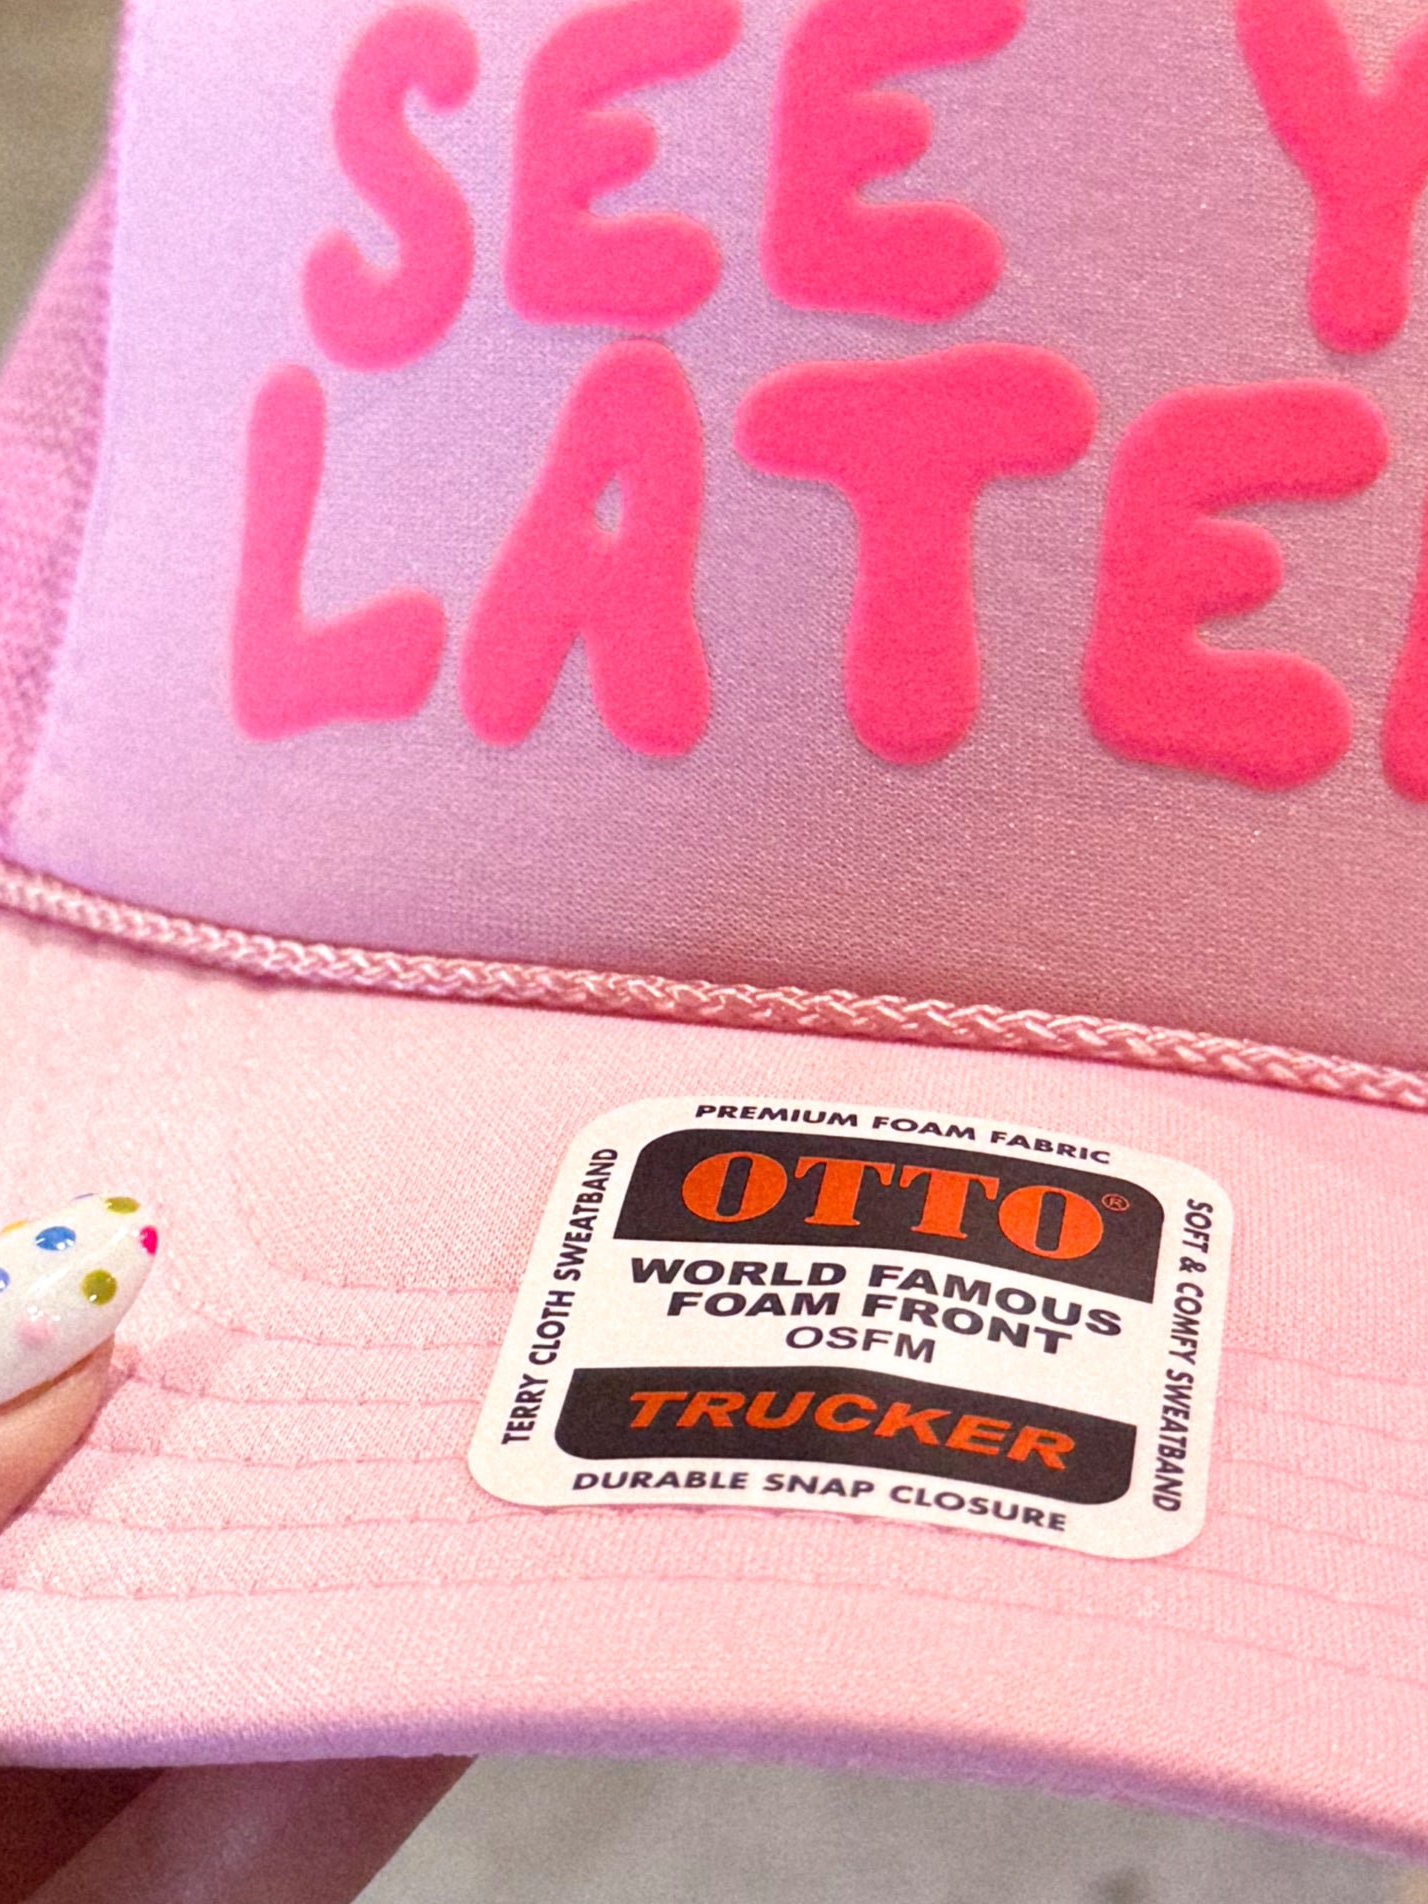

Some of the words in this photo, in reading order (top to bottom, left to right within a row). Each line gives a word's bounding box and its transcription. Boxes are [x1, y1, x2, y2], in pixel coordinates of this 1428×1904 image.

[695, 1104, 859, 1128] PREMIUM
[872, 1116, 976, 1141] FOAM
[990, 1130, 1111, 1164] FABRIC
[681, 1151, 1104, 1260] OTTO
[1185, 1199, 1213, 1253] SOFT
[501, 1369, 550, 1445] TERRY
[528, 1289, 576, 1365] CLOTH
[554, 1147, 618, 1282] SWEATBAND
[631, 1258, 847, 1287] WORLD
[869, 1263, 1123, 1336] FAMOUS
[1181, 1256, 1207, 1273] &
[667, 1291, 840, 1317] FOAM
[862, 1294, 1072, 1355] FRONT
[785, 1326, 935, 1363] OSFM
[1170, 1278, 1205, 1365] COMFY
[627, 1390, 1075, 1471] TRUCKER
[1153, 1369, 1198, 1512] SWEATBAND
[572, 1469, 748, 1492] DURABLE
[764, 1472, 875, 1499] SNAP
[890, 1485, 1067, 1532] CLOSURE
